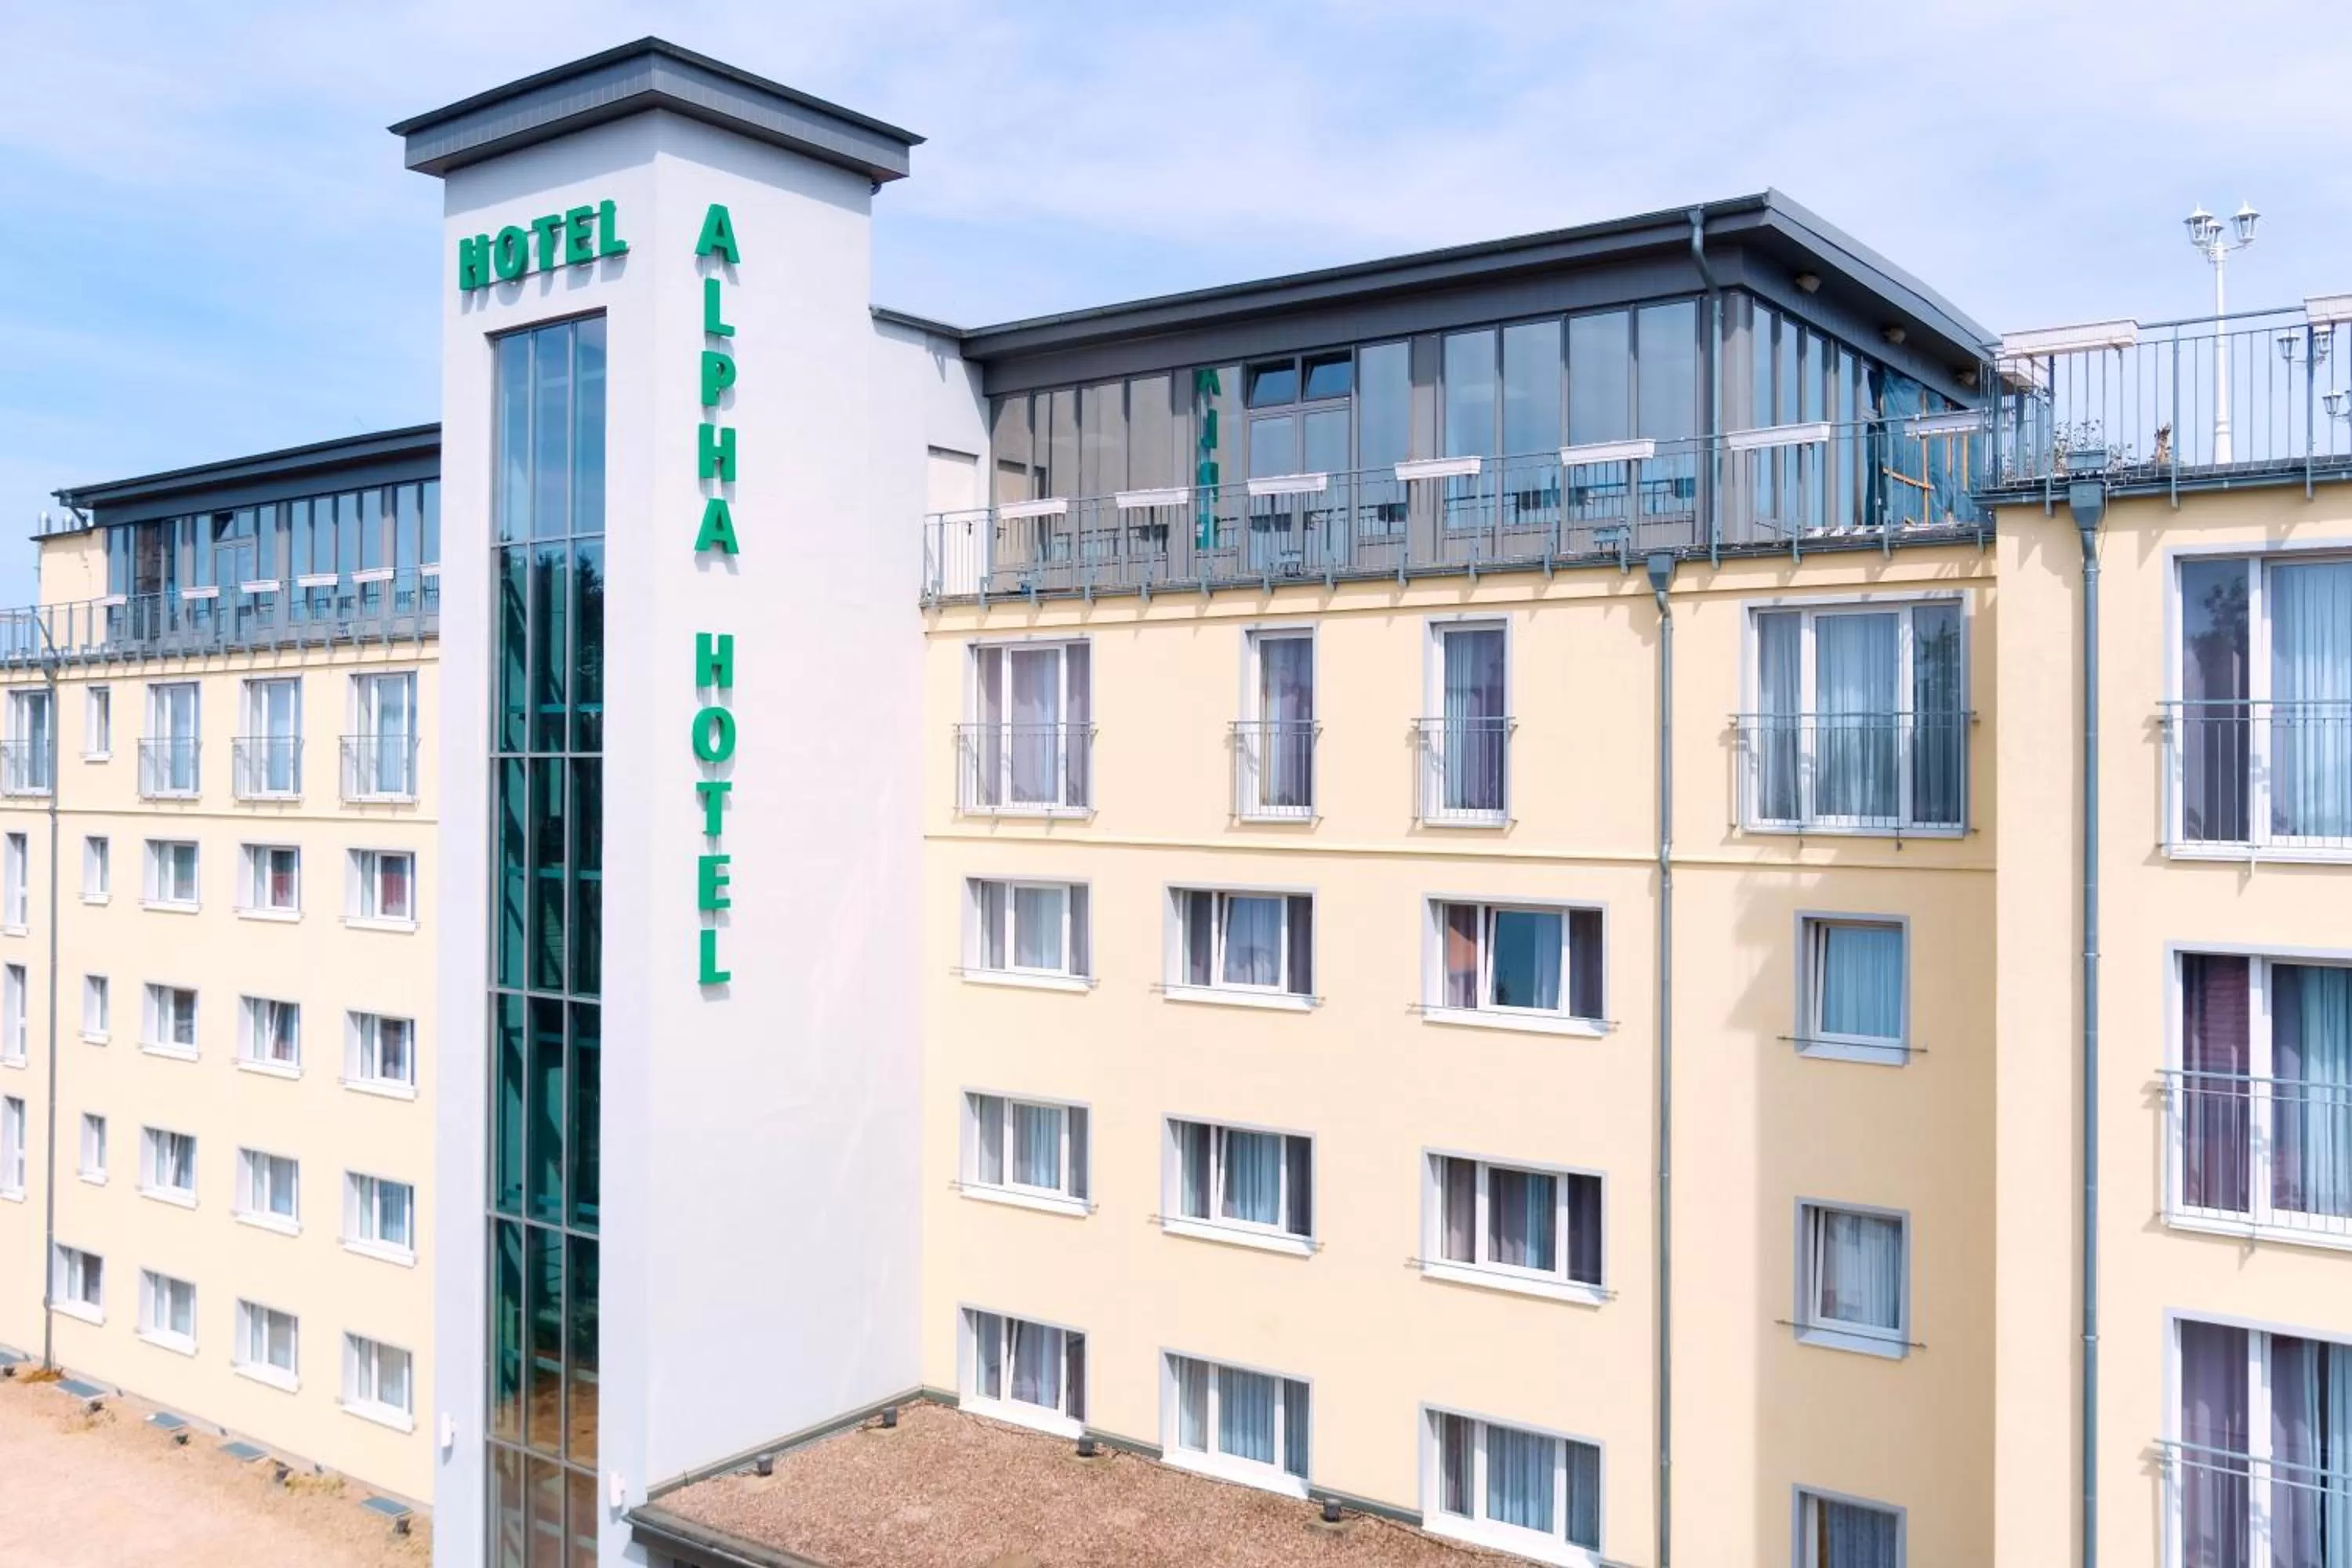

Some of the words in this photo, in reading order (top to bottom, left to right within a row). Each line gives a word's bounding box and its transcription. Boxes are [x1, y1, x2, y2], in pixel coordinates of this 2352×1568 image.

[459, 199, 627, 290] HOTEL
[695, 204, 740, 555] ALPHA
[692, 633, 735, 985] HOTEL
